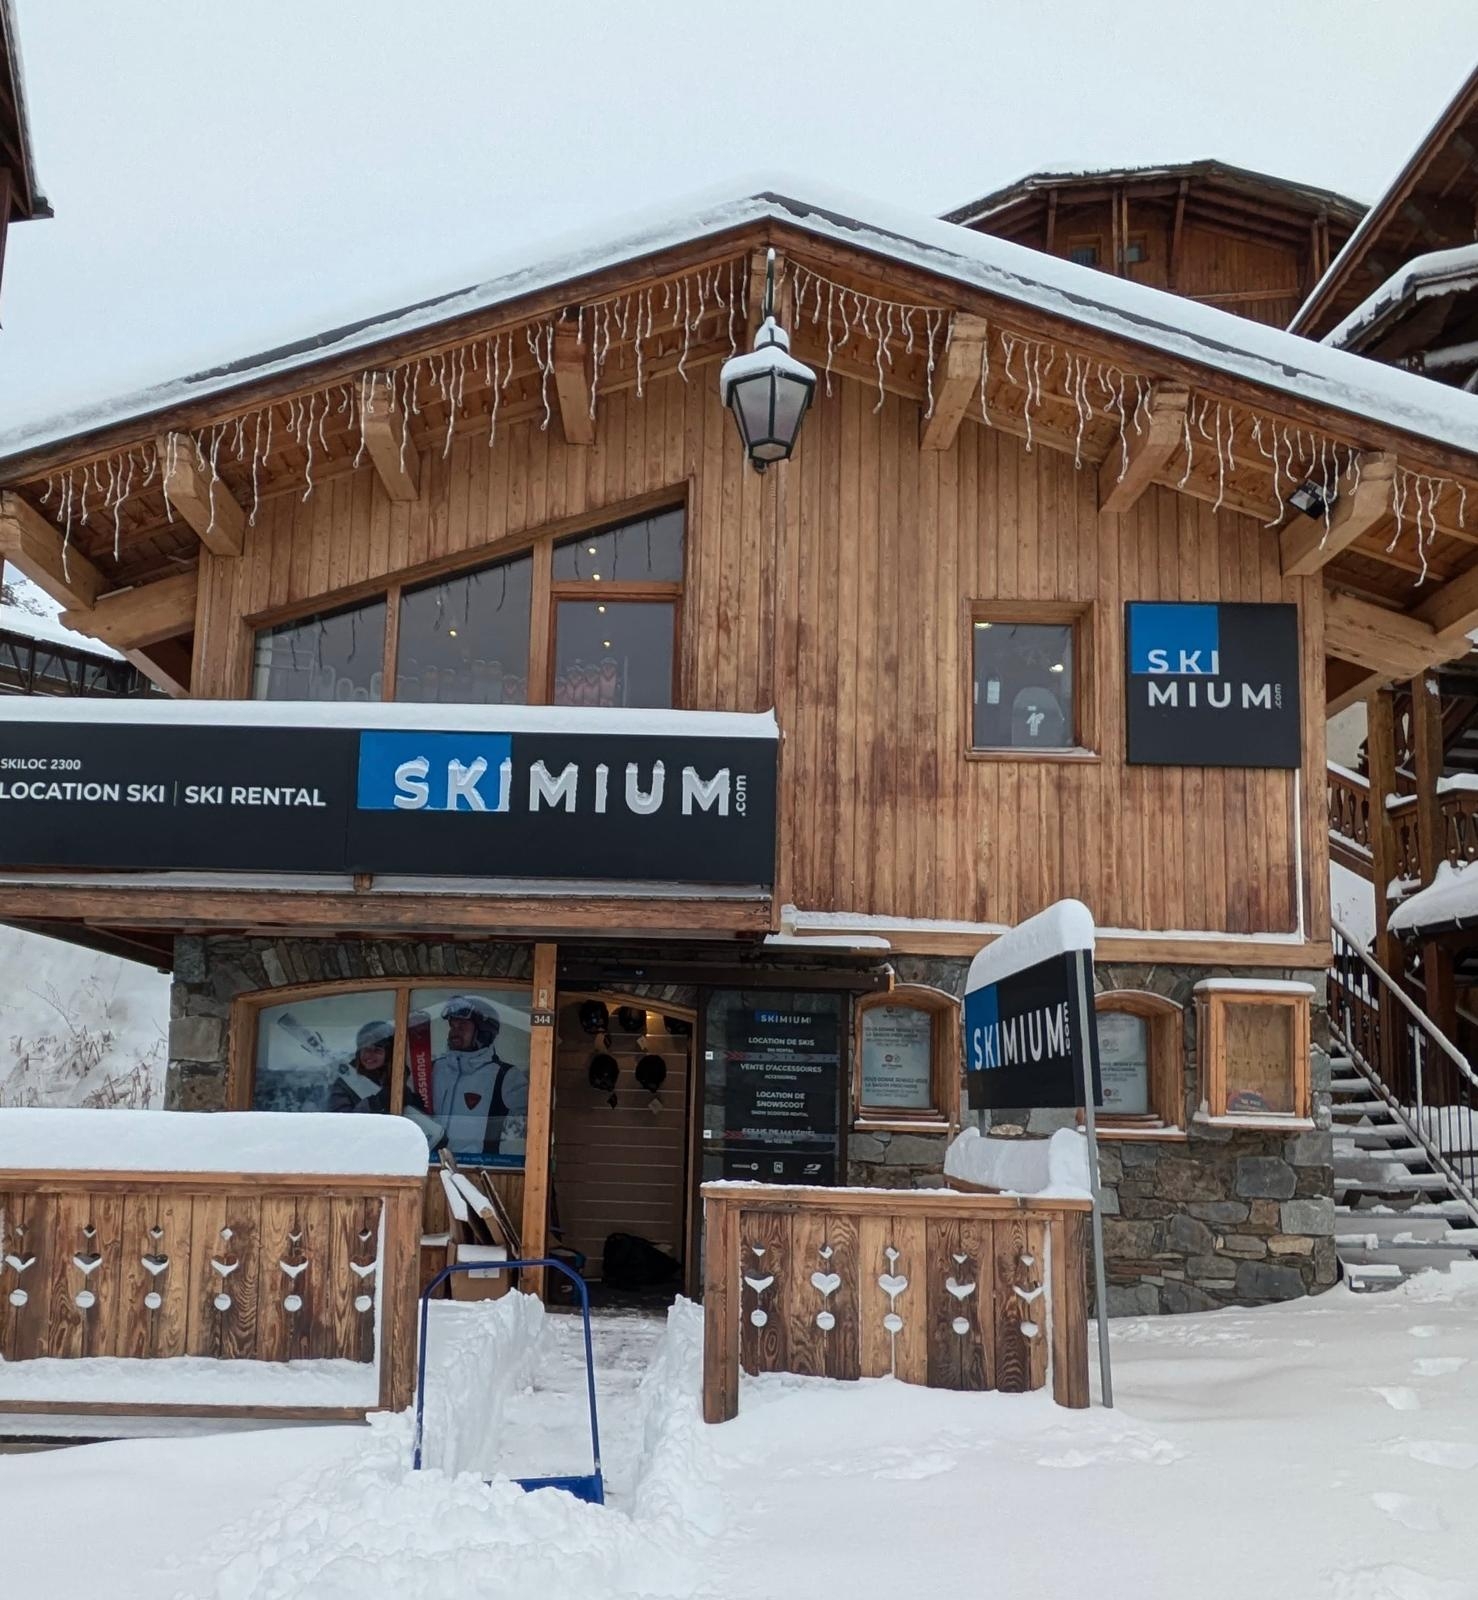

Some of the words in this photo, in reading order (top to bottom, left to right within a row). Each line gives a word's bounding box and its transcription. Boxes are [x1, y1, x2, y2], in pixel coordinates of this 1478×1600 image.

[1147, 649, 1219, 675] SKI
[1148, 681, 1272, 709] MIUM
[1274, 683, 1282, 709] .com
[0, 758, 47, 770] SKILOC
[50, 759, 81, 770] 2300
[0, 782, 119, 801] LOCATION
[127, 785, 165, 803] SKI
[184, 785, 223, 804] SKI
[230, 786, 326, 806] RENTAL
[393, 756, 730, 817] SKIMIUM
[732, 774, 748, 817] .com
[534, 1015, 551, 1024] 344
[760, 1014, 810, 1024] SKIMIUM
[1063, 1001, 1071, 1056] .com
[748, 1037, 785, 1045] LOCATION
[973, 1003, 1065, 1071] SKIMIUM
[740, 1063, 764, 1071] VENTE
[765, 1064, 822, 1073] D'ACCESSOIRES
[756, 1091, 793, 1099] LOCATION
[756, 1100, 805, 1108] SNOWSCOOT
